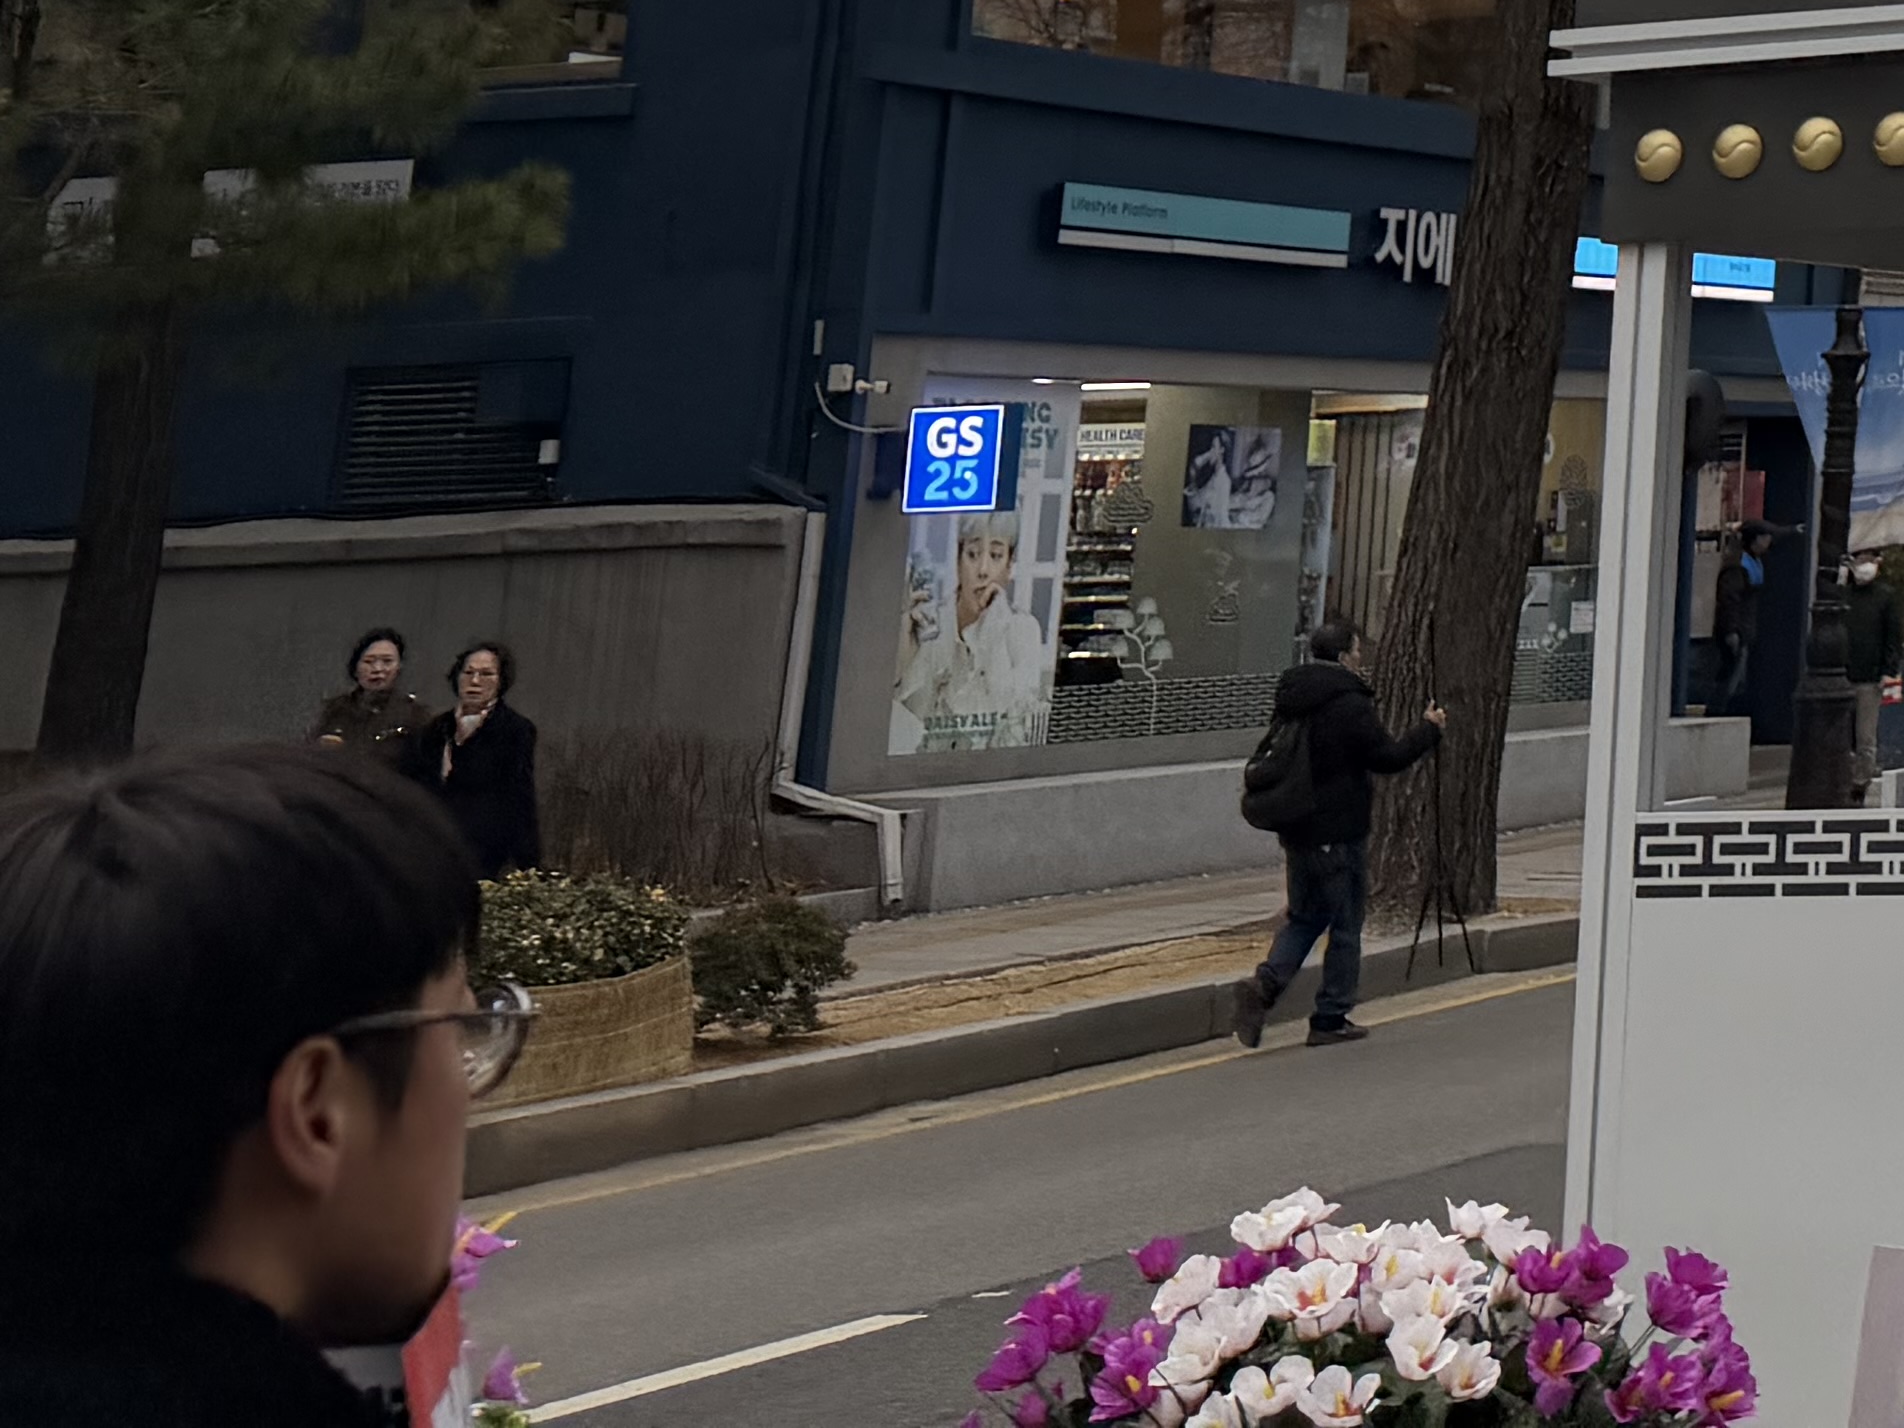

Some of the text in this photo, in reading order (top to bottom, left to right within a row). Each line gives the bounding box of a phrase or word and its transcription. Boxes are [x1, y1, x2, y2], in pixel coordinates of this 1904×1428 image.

[1070, 196, 1169, 220] Lifestyle Platform
[926, 415, 984, 459] GS
[1080, 429, 1117, 443] HEALTH
[923, 458, 979, 502] 25
